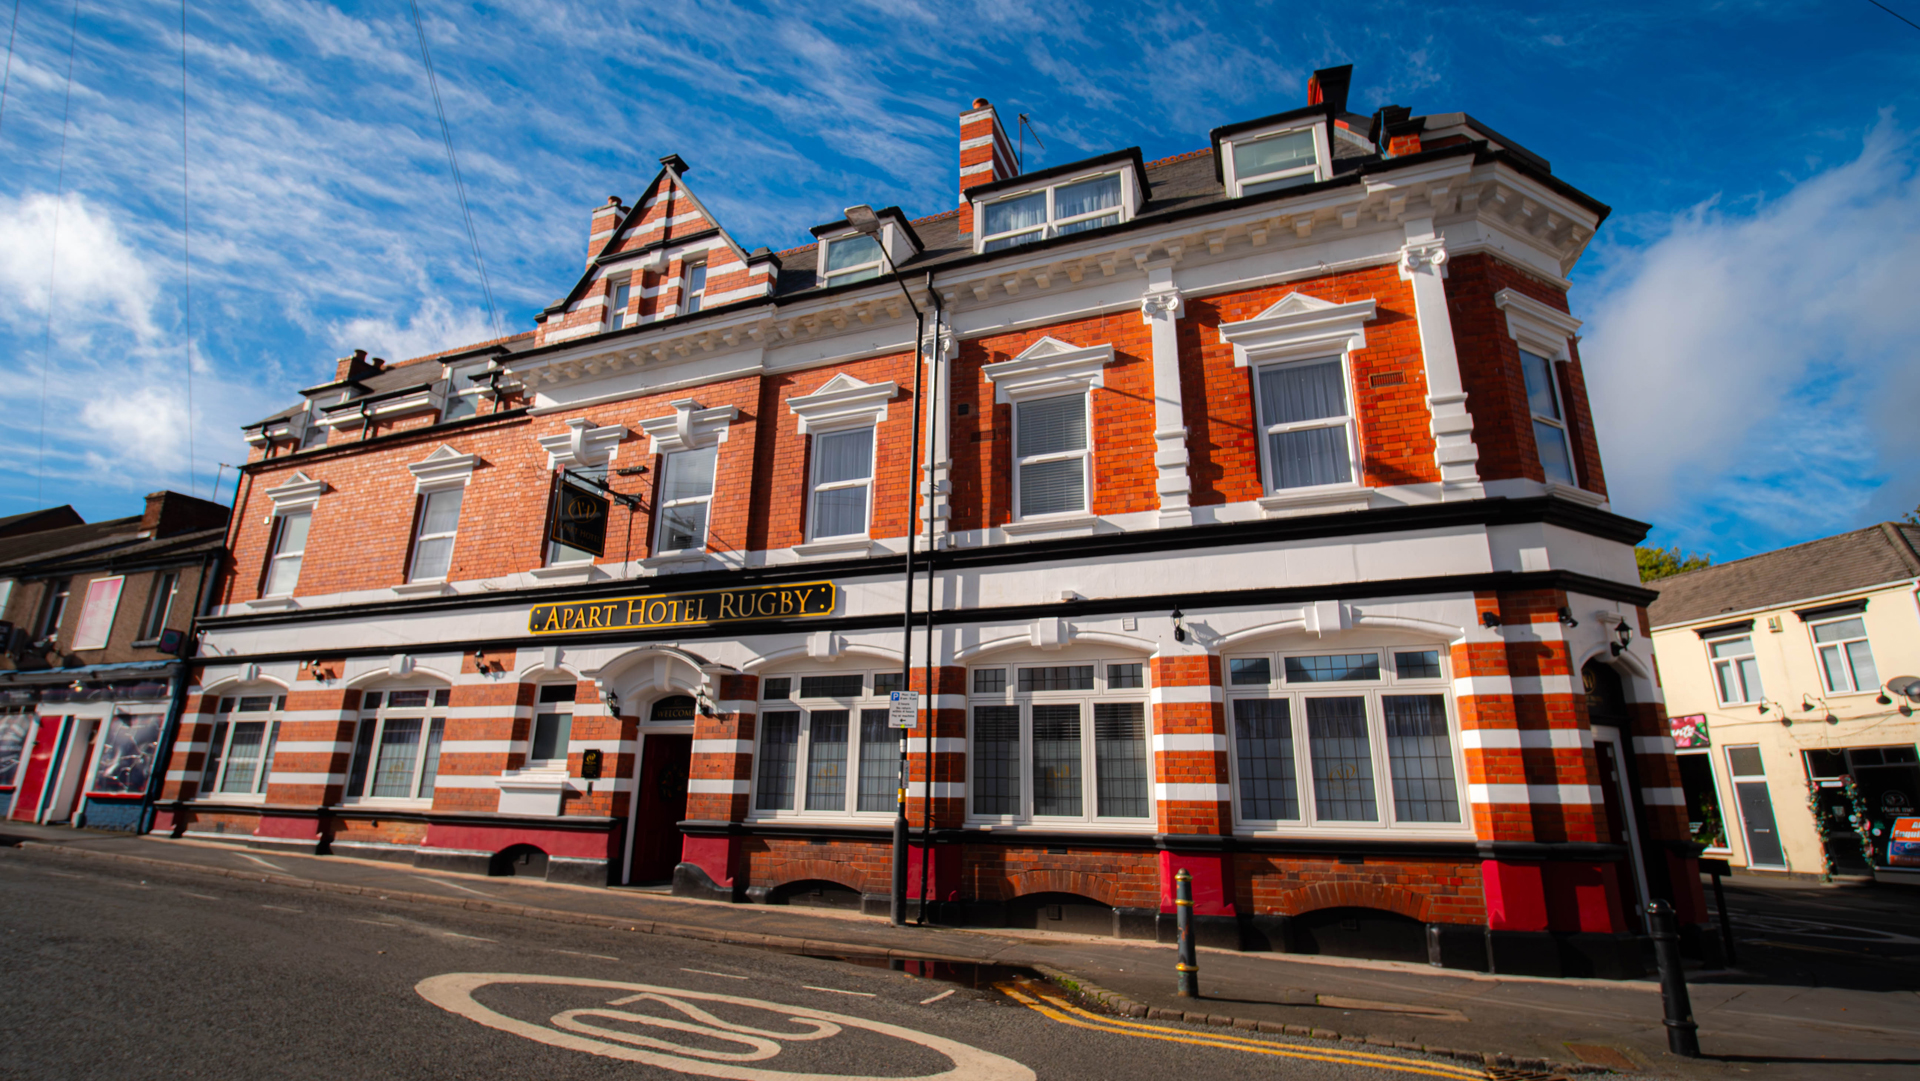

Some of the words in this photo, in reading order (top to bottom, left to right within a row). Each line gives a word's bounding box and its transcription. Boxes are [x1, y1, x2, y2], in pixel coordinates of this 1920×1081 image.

[543, 605, 617, 630] APART
[625, 599, 708, 624] HOTEL
[718, 589, 813, 619] RUGBY
[657, 709, 695, 718] WELCOME
